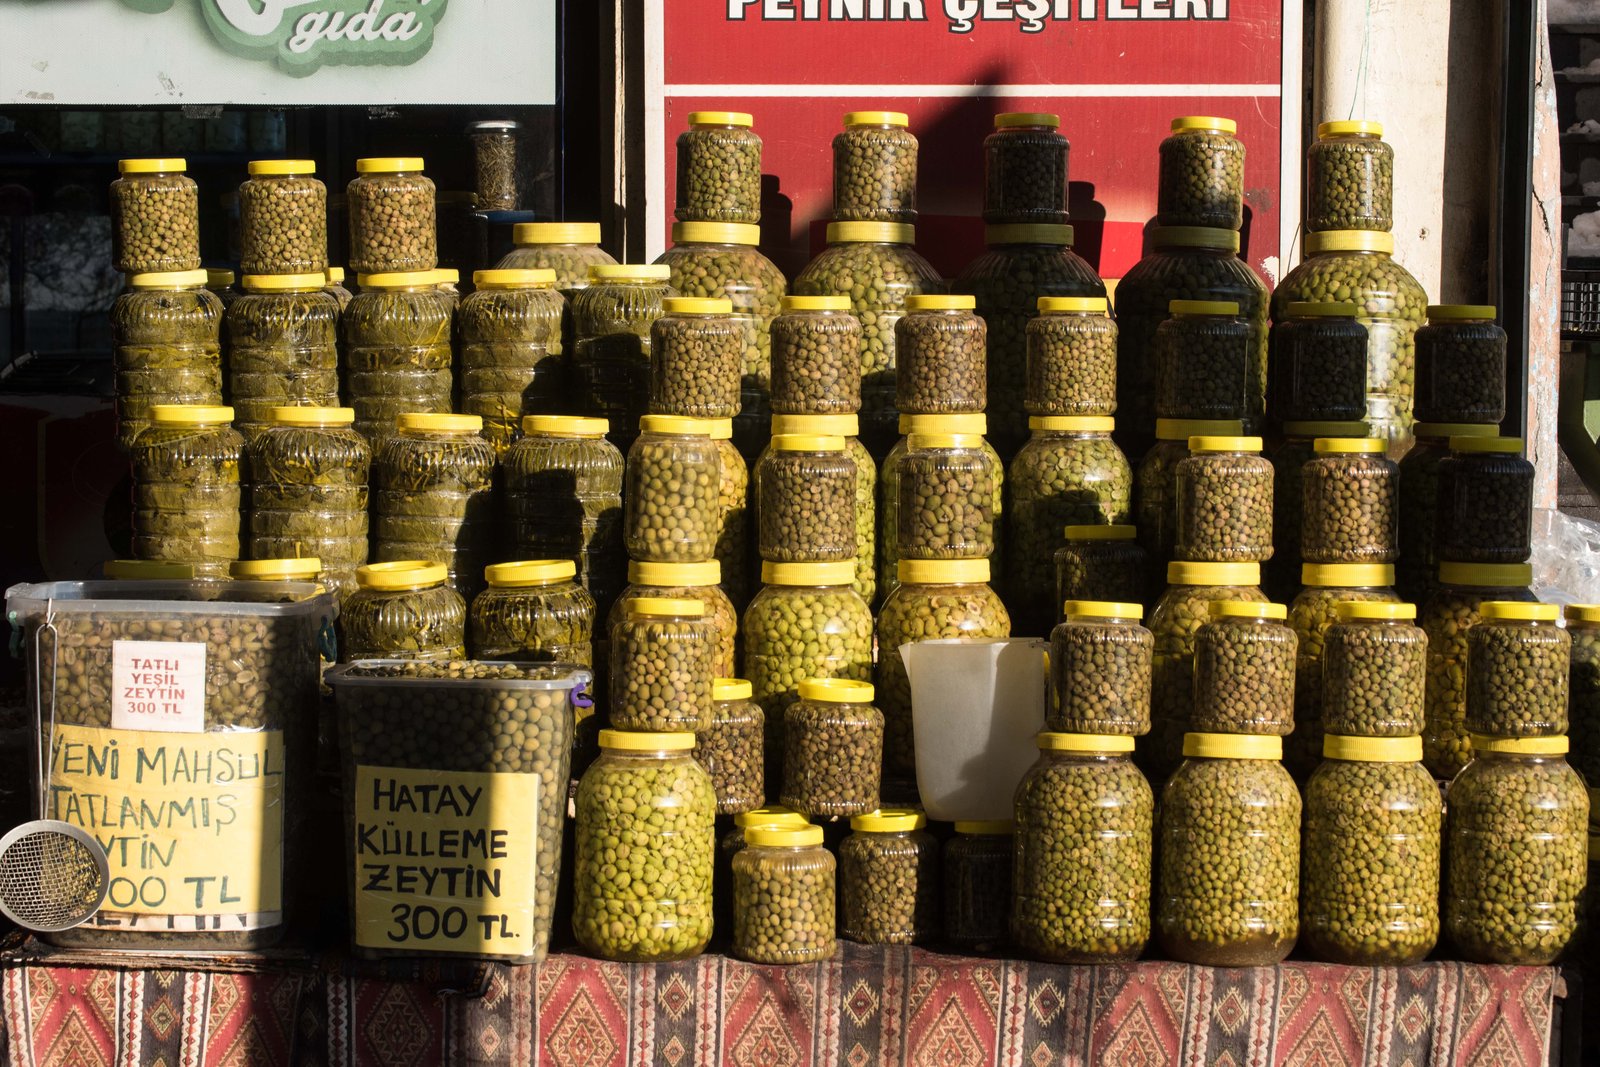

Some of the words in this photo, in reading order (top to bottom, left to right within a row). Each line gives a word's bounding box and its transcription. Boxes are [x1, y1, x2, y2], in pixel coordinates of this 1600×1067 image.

[131, 658, 179, 671] TATLI
[131, 671, 179, 688] YEŞİL
[124, 686, 185, 700] ZEYTİN
[127, 701, 156, 714] 300
[162, 703, 182, 714] TL
[373, 778, 482, 817] HATAY
[358, 821, 509, 860] KÜLLEME
[108, 876, 167, 908] 00
[184, 875, 241, 909] TL
[362, 864, 501, 898] ZEYTİN
[387, 903, 468, 942] 300
[477, 914, 520, 940] TL.
